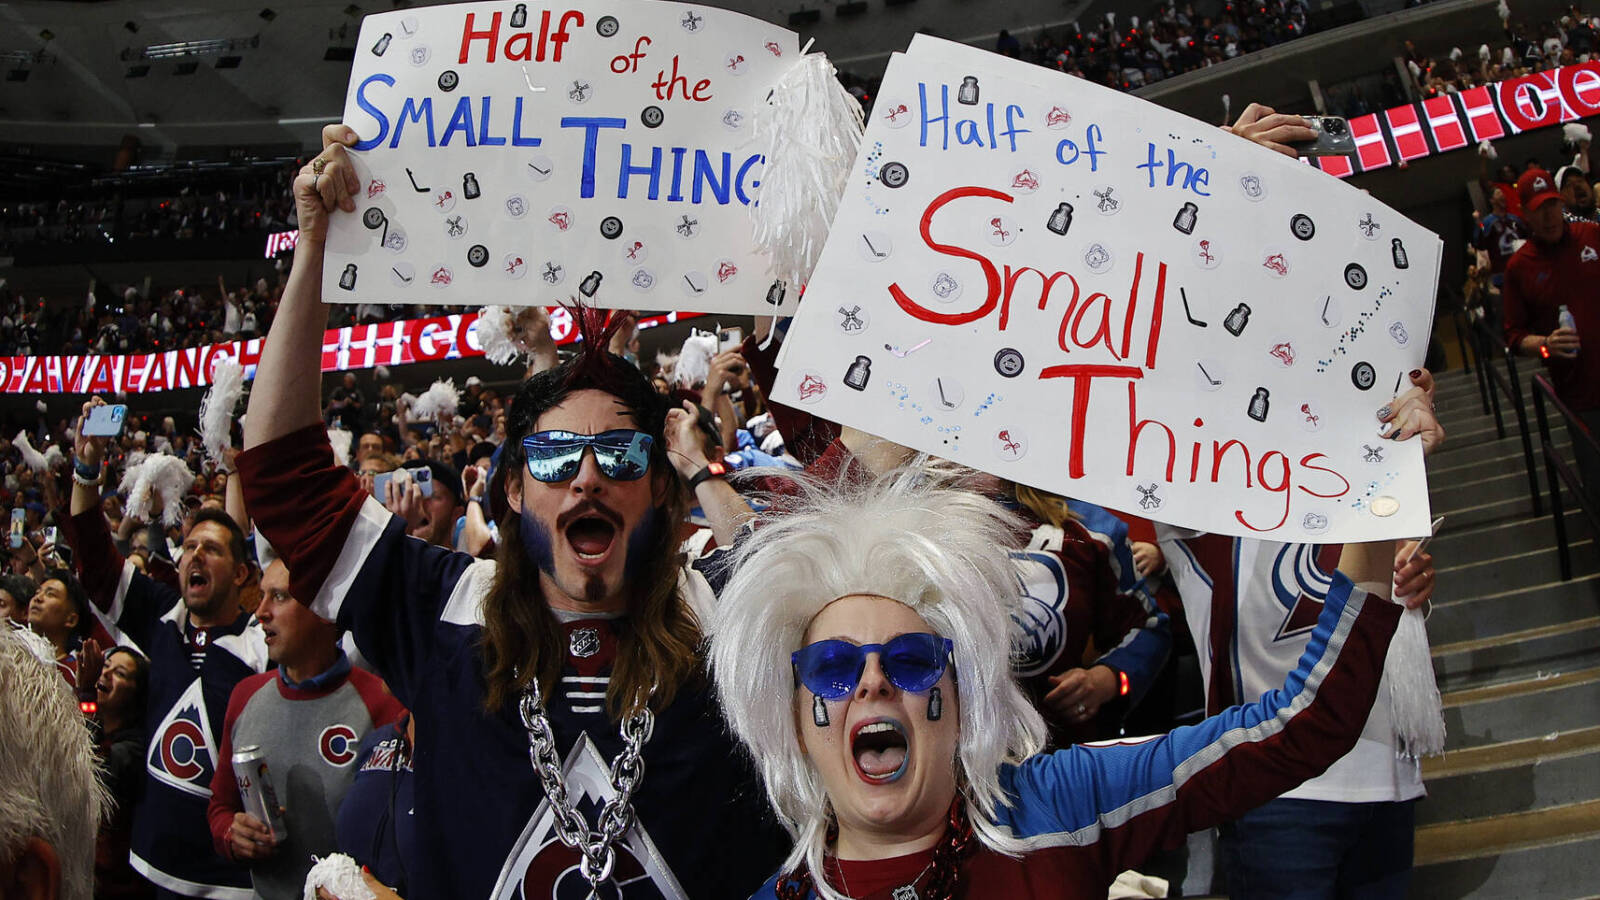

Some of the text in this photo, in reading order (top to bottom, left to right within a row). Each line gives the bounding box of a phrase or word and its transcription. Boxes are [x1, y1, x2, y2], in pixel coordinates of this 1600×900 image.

[459, 10, 713, 101] Half of the
[355, 73, 542, 151] SMALL
[918, 82, 1212, 197] Half of the
[888, 186, 1167, 370] Small
[1039, 364, 1350, 532] Things
[318, 724, 358, 768] C
